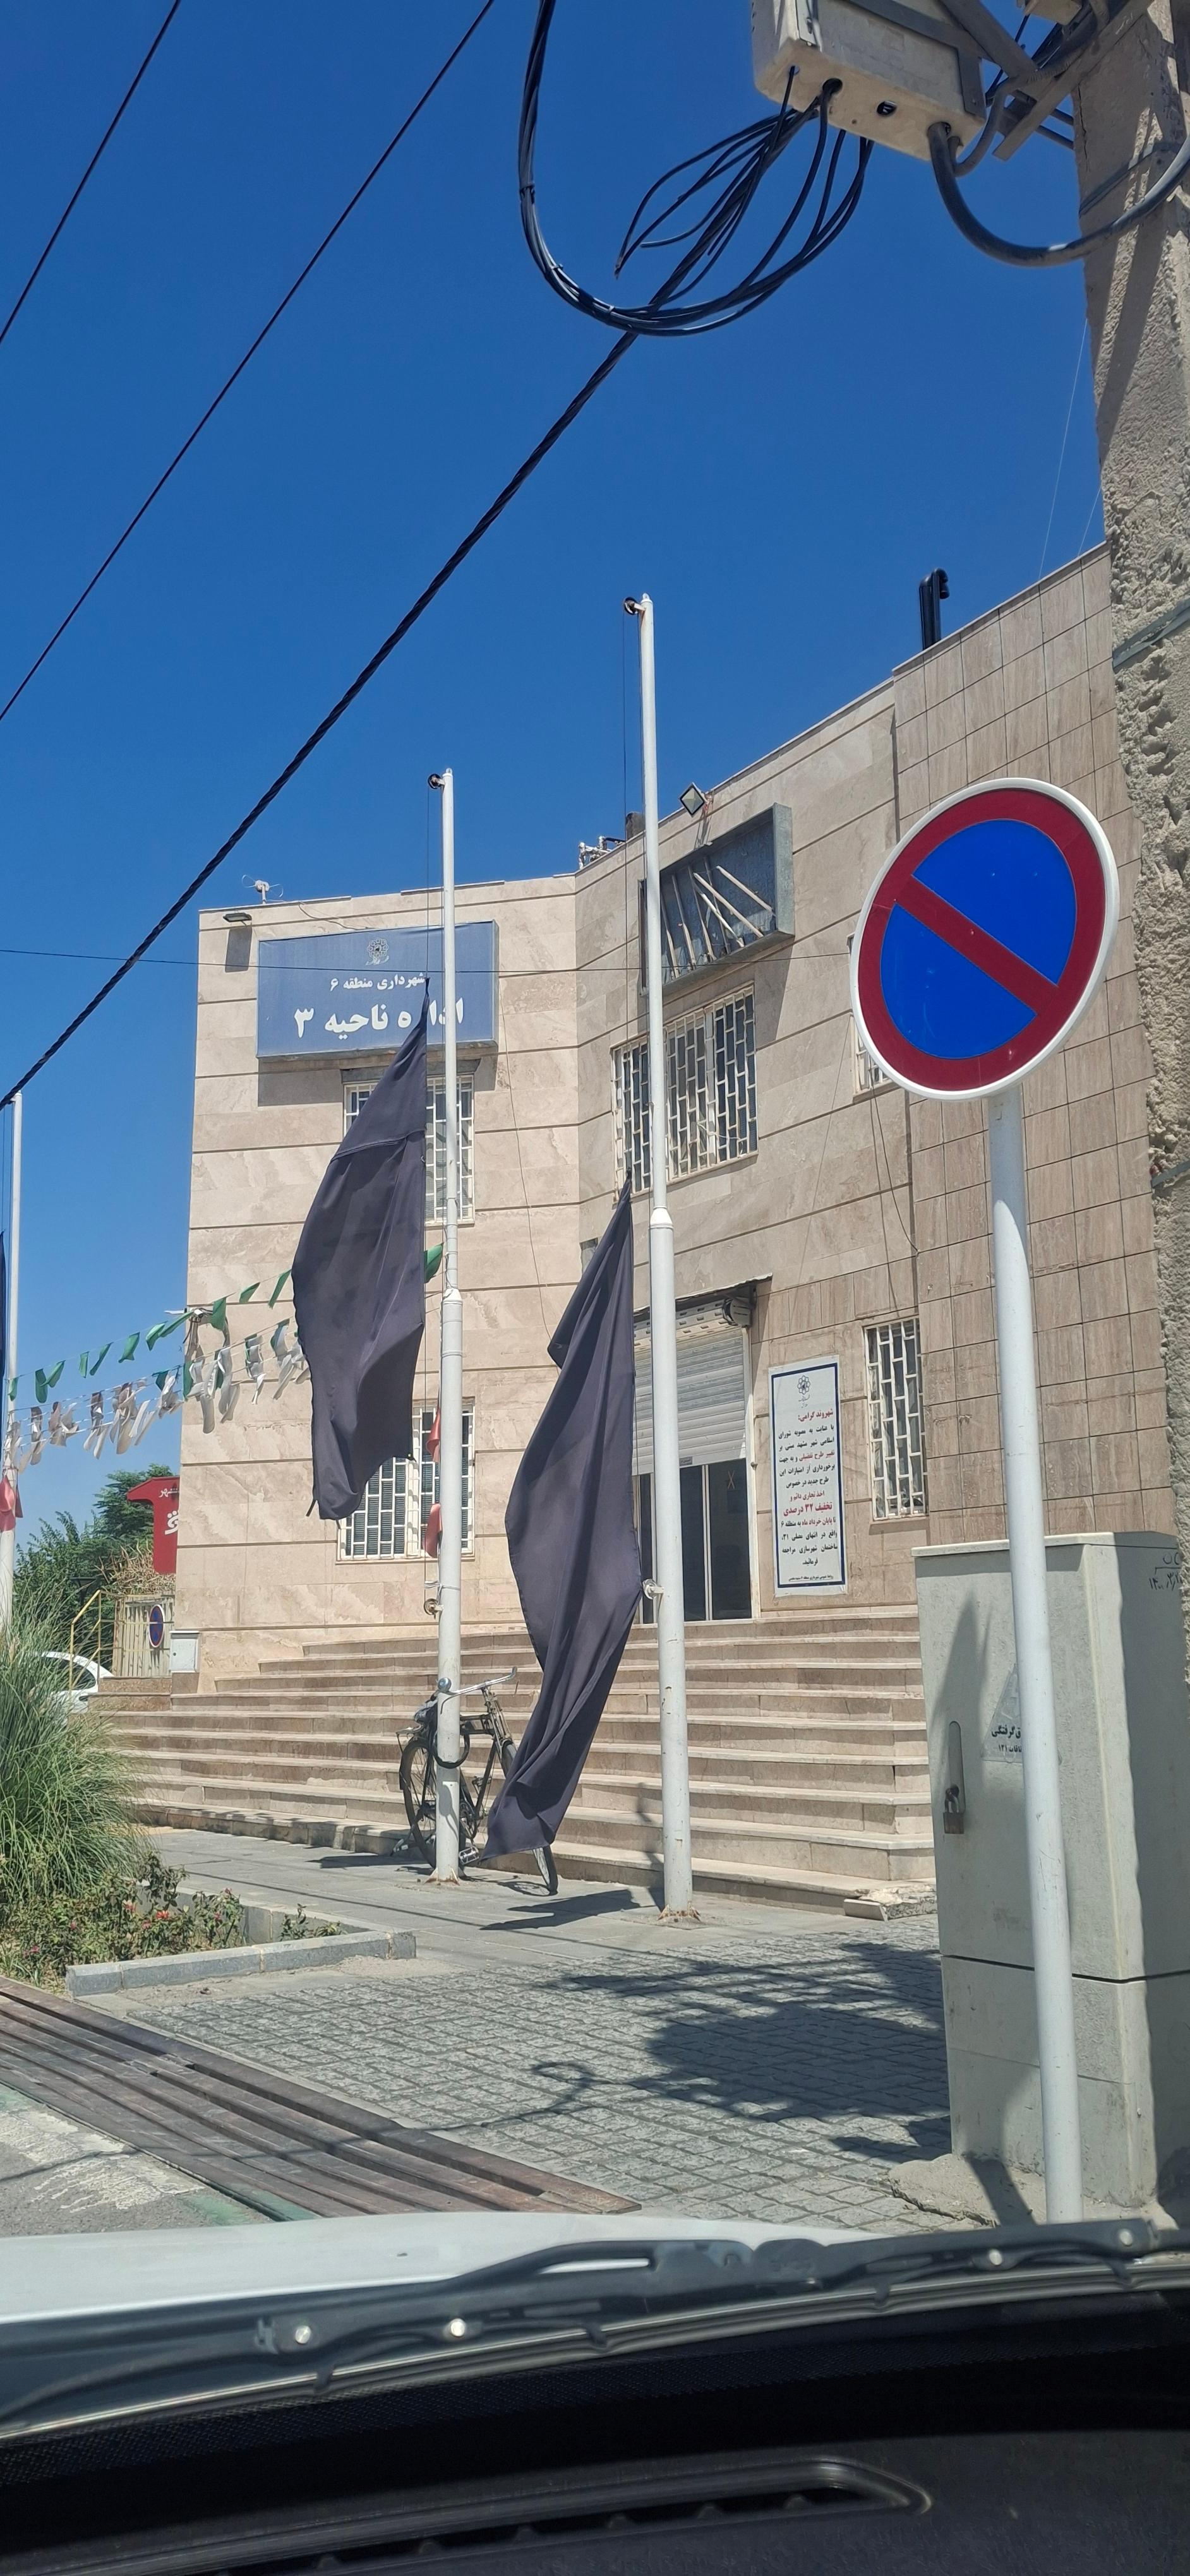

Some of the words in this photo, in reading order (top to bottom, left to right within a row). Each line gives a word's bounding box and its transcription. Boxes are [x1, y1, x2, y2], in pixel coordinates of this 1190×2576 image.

[330, 978, 339, 991] ۶
[344, 975, 373, 990] منطقه
[377, 973, 426, 990] شهرداری
[294, 1008, 314, 1039] ۳
[325, 1004, 388, 1039] ناحیه
[816, 1409, 834, 1419] شهروند
[778, 1431, 791, 1439] شورای
[820, 1436, 834, 1446] اسلامی
[814, 1451, 824, 1460] طرح
[806, 1464, 810, 1474] از
[813, 1463, 835, 1473] برخورداری
[786, 1479, 801, 1489] خصوص
[802, 1479, 807, 1488] در
[819, 1476, 829, 1485] طرح
[815, 1501, 832, 1513] تخفیف
[782, 1546, 796, 1554] مراجعه
[820, 1543, 838, 1553] ساختمان
[992, 1724, 1015, 1739] گرفتگی
[999, 1744, 1007, 1753] ۱۲۱
